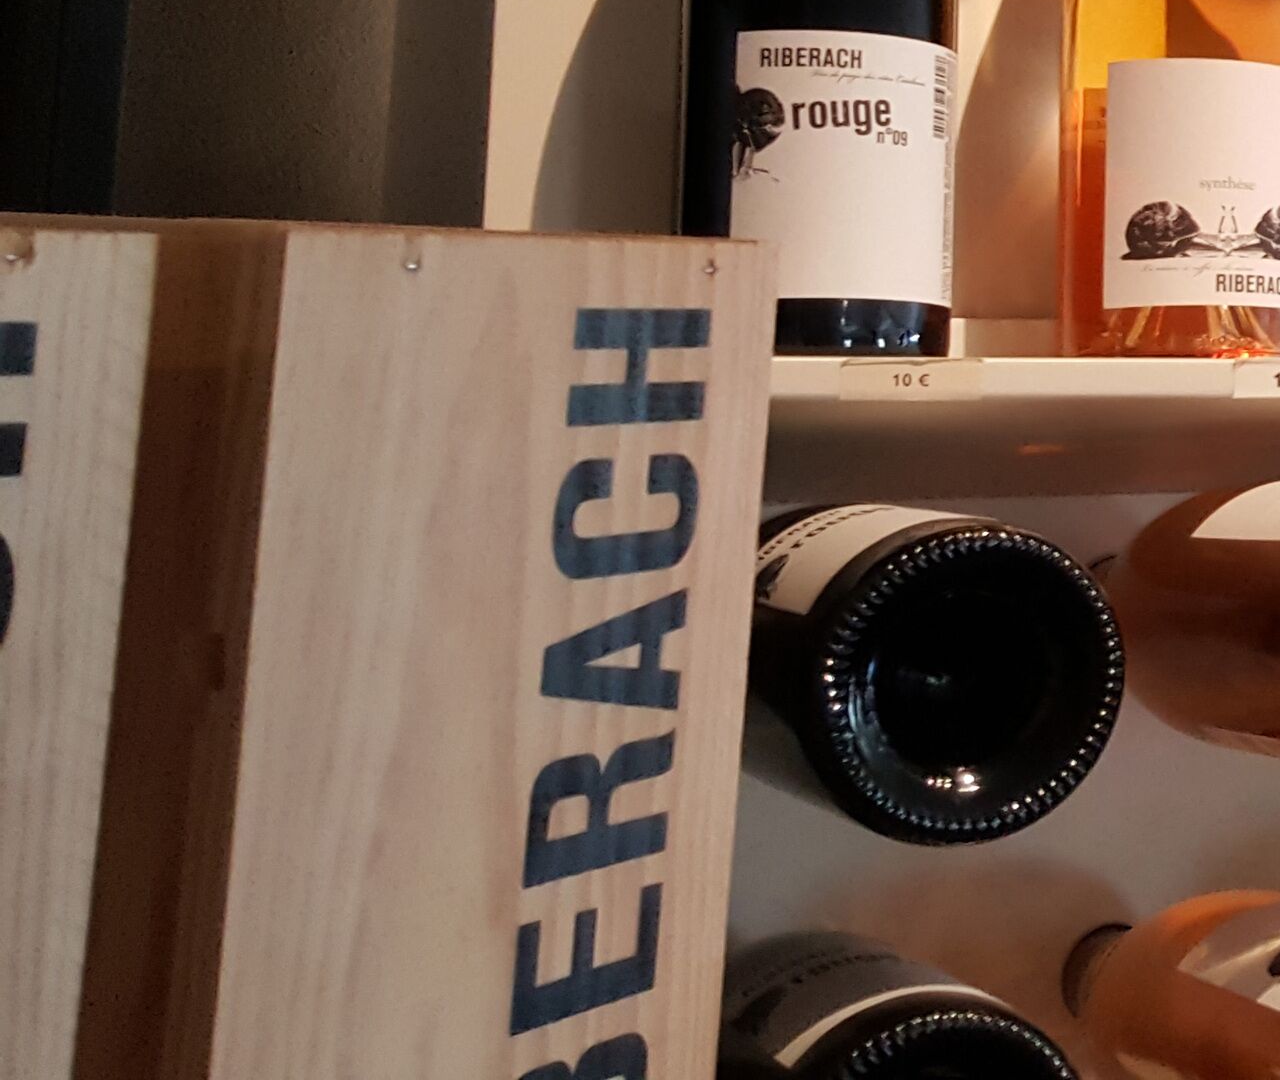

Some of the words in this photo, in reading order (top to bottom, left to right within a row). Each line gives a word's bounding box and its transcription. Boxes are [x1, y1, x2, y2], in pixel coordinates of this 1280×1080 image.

[760, 47, 863, 69] RIBERACH
[791, 98, 892, 136] rouge
[892, 373, 913, 388] 10
[919, 374, 931, 388] €
